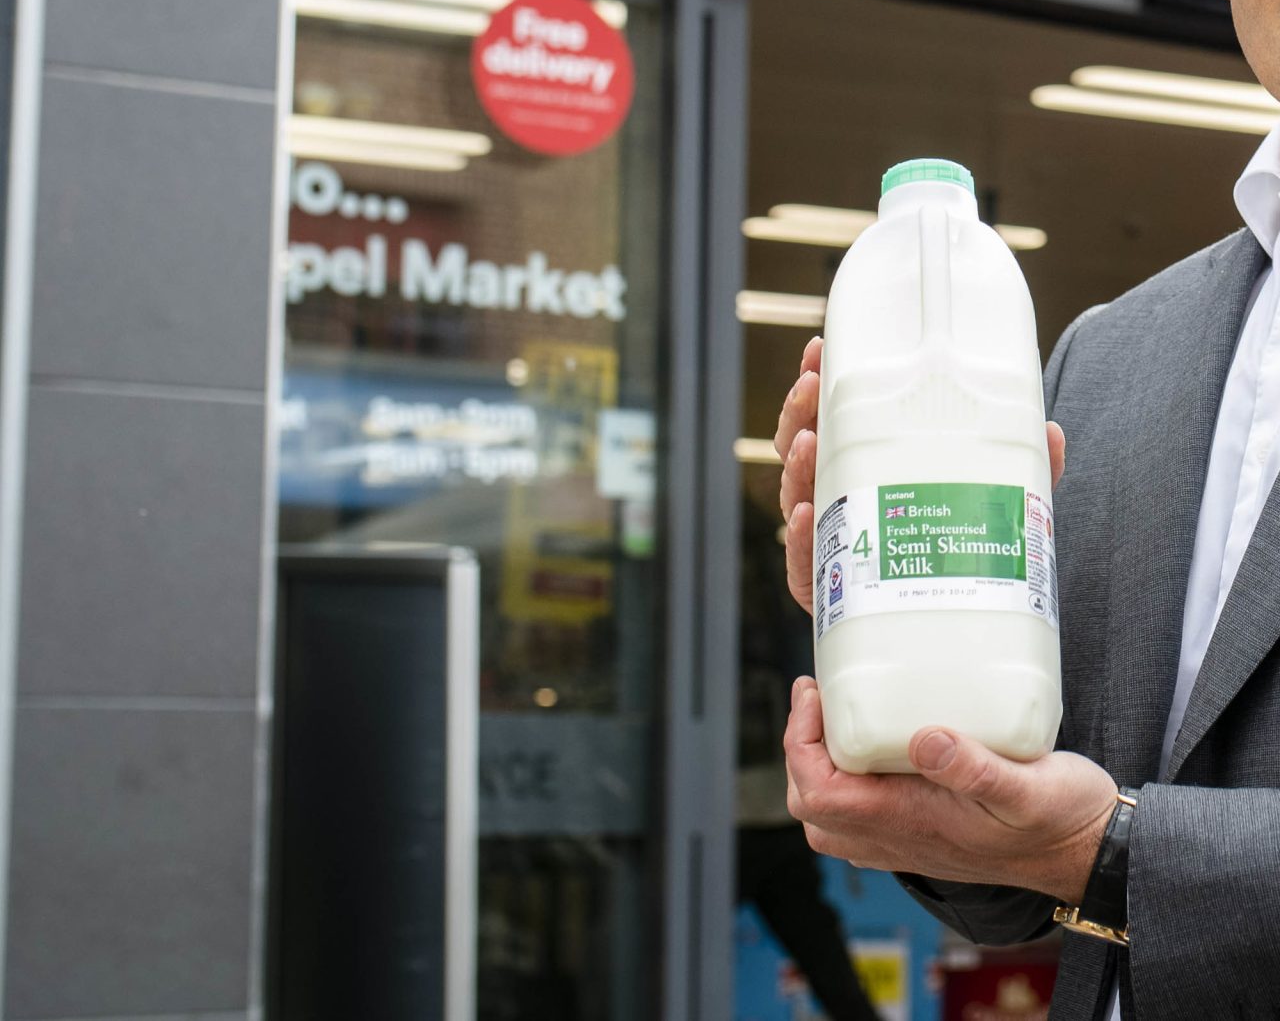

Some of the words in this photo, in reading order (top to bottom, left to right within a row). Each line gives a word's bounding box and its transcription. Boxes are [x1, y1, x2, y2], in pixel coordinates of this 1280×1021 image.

[512, 7, 587, 51] Free
[481, 39, 615, 94] delivery
[291, 162, 409, 225] o...
[402, 238, 627, 321] Market
[885, 491, 915, 500] Iceland
[908, 505, 951, 518] British
[886, 525, 918, 536] Fresh
[921, 523, 987, 535] Pasteurised
[852, 529, 873, 558] 4
[887, 537, 931, 556] Semi
[937, 537, 1021, 556] Skimmed
[888, 559, 934, 576] Milk
